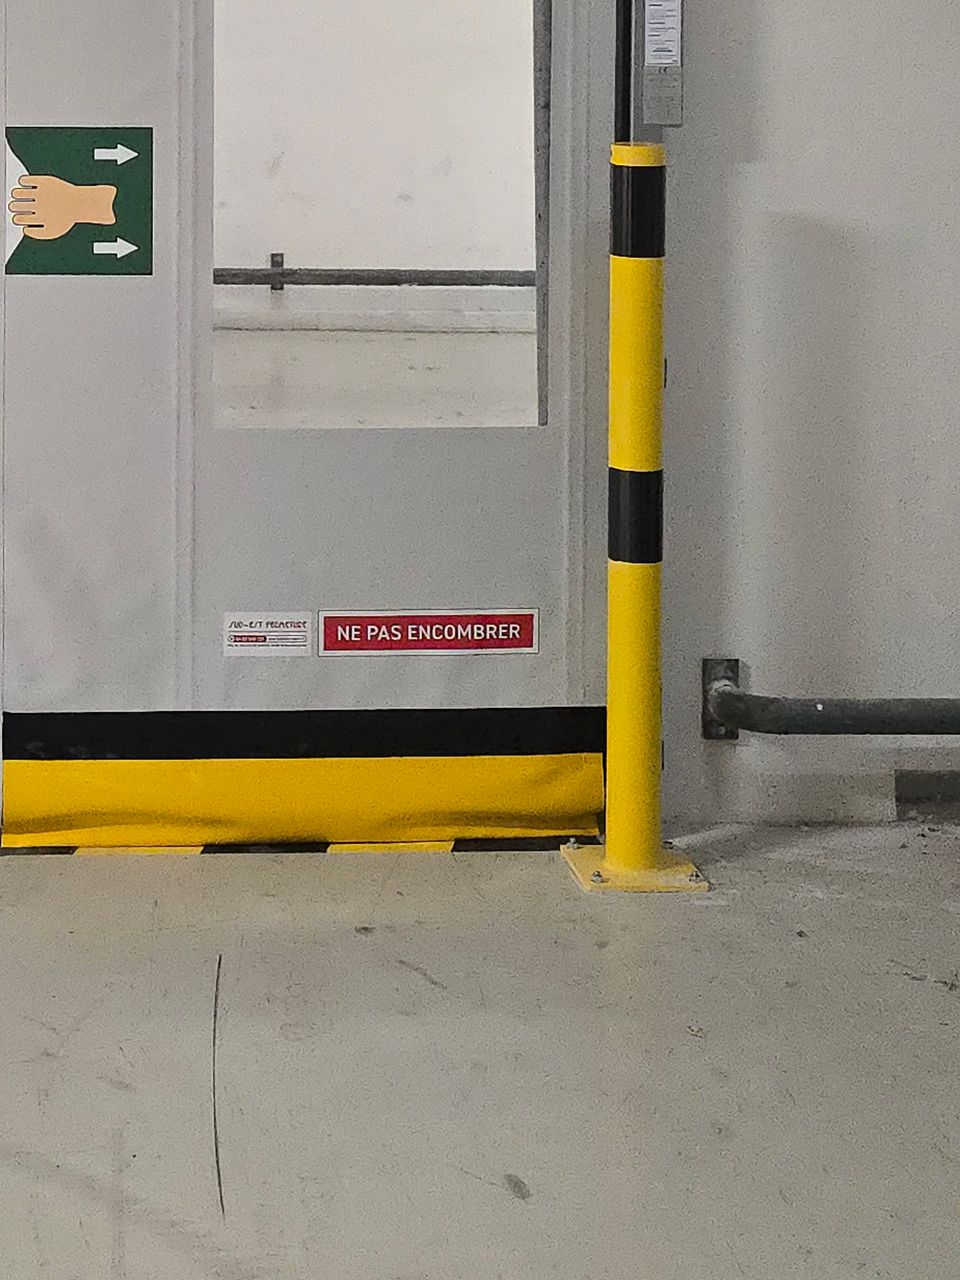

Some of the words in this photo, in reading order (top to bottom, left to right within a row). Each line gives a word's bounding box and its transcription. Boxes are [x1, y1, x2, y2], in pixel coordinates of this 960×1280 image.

[337, 625, 361, 641] NE
[367, 625, 402, 641] PAS
[408, 624, 520, 640] ENCOMBRER
